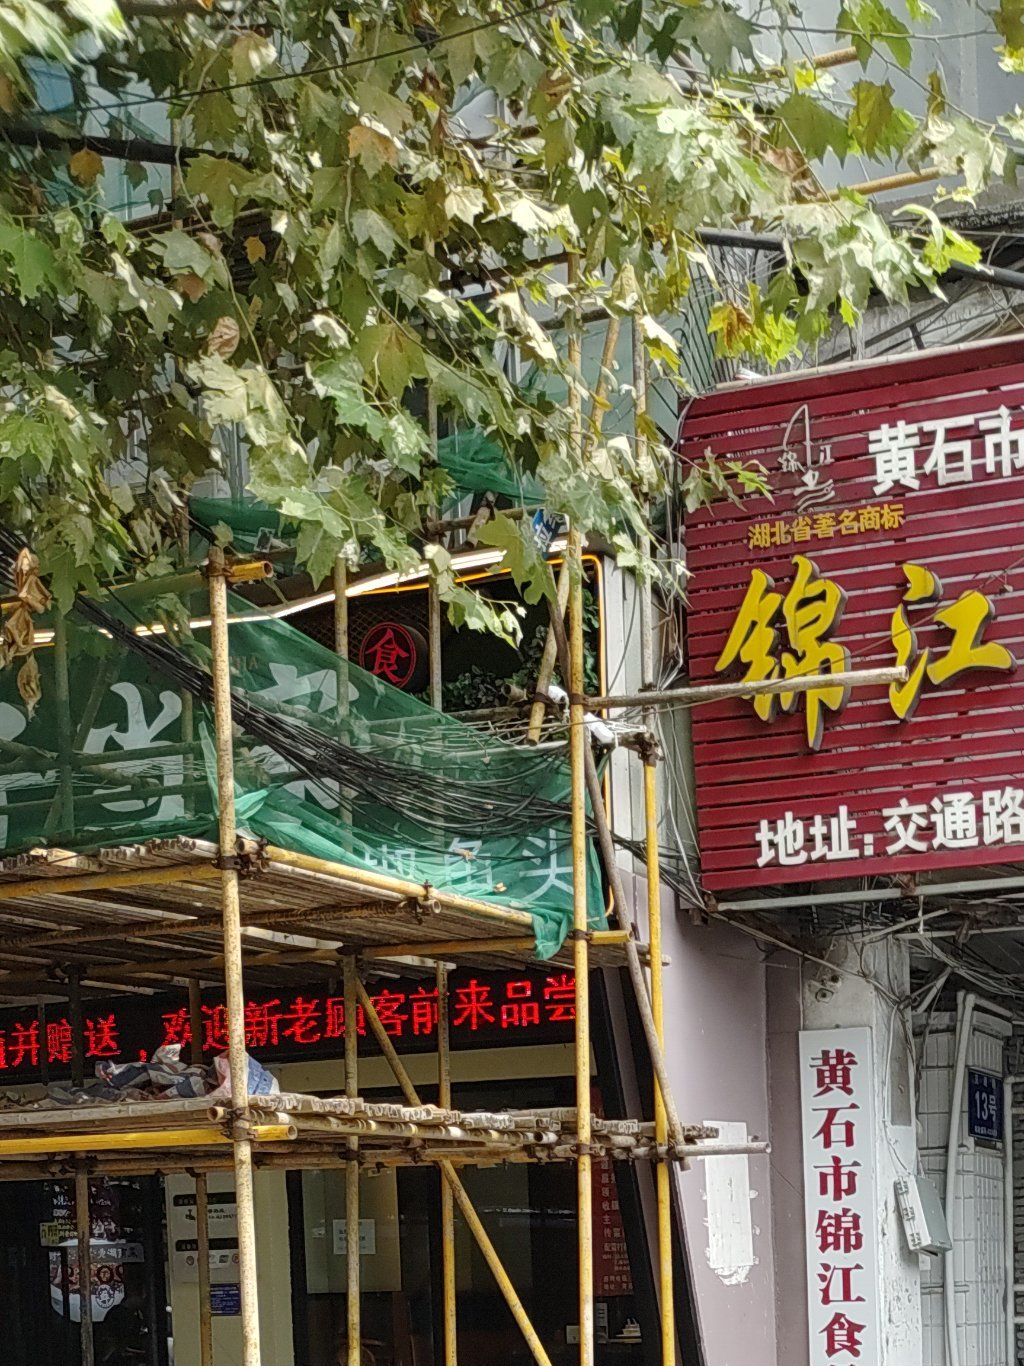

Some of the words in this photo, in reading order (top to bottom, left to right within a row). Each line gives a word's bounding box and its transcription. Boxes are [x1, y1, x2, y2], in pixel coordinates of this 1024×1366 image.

[748, 503, 905, 549] 湖北省著名商标
[365, 628, 409, 683] 食
[974, 1090, 998, 1122] 13号
